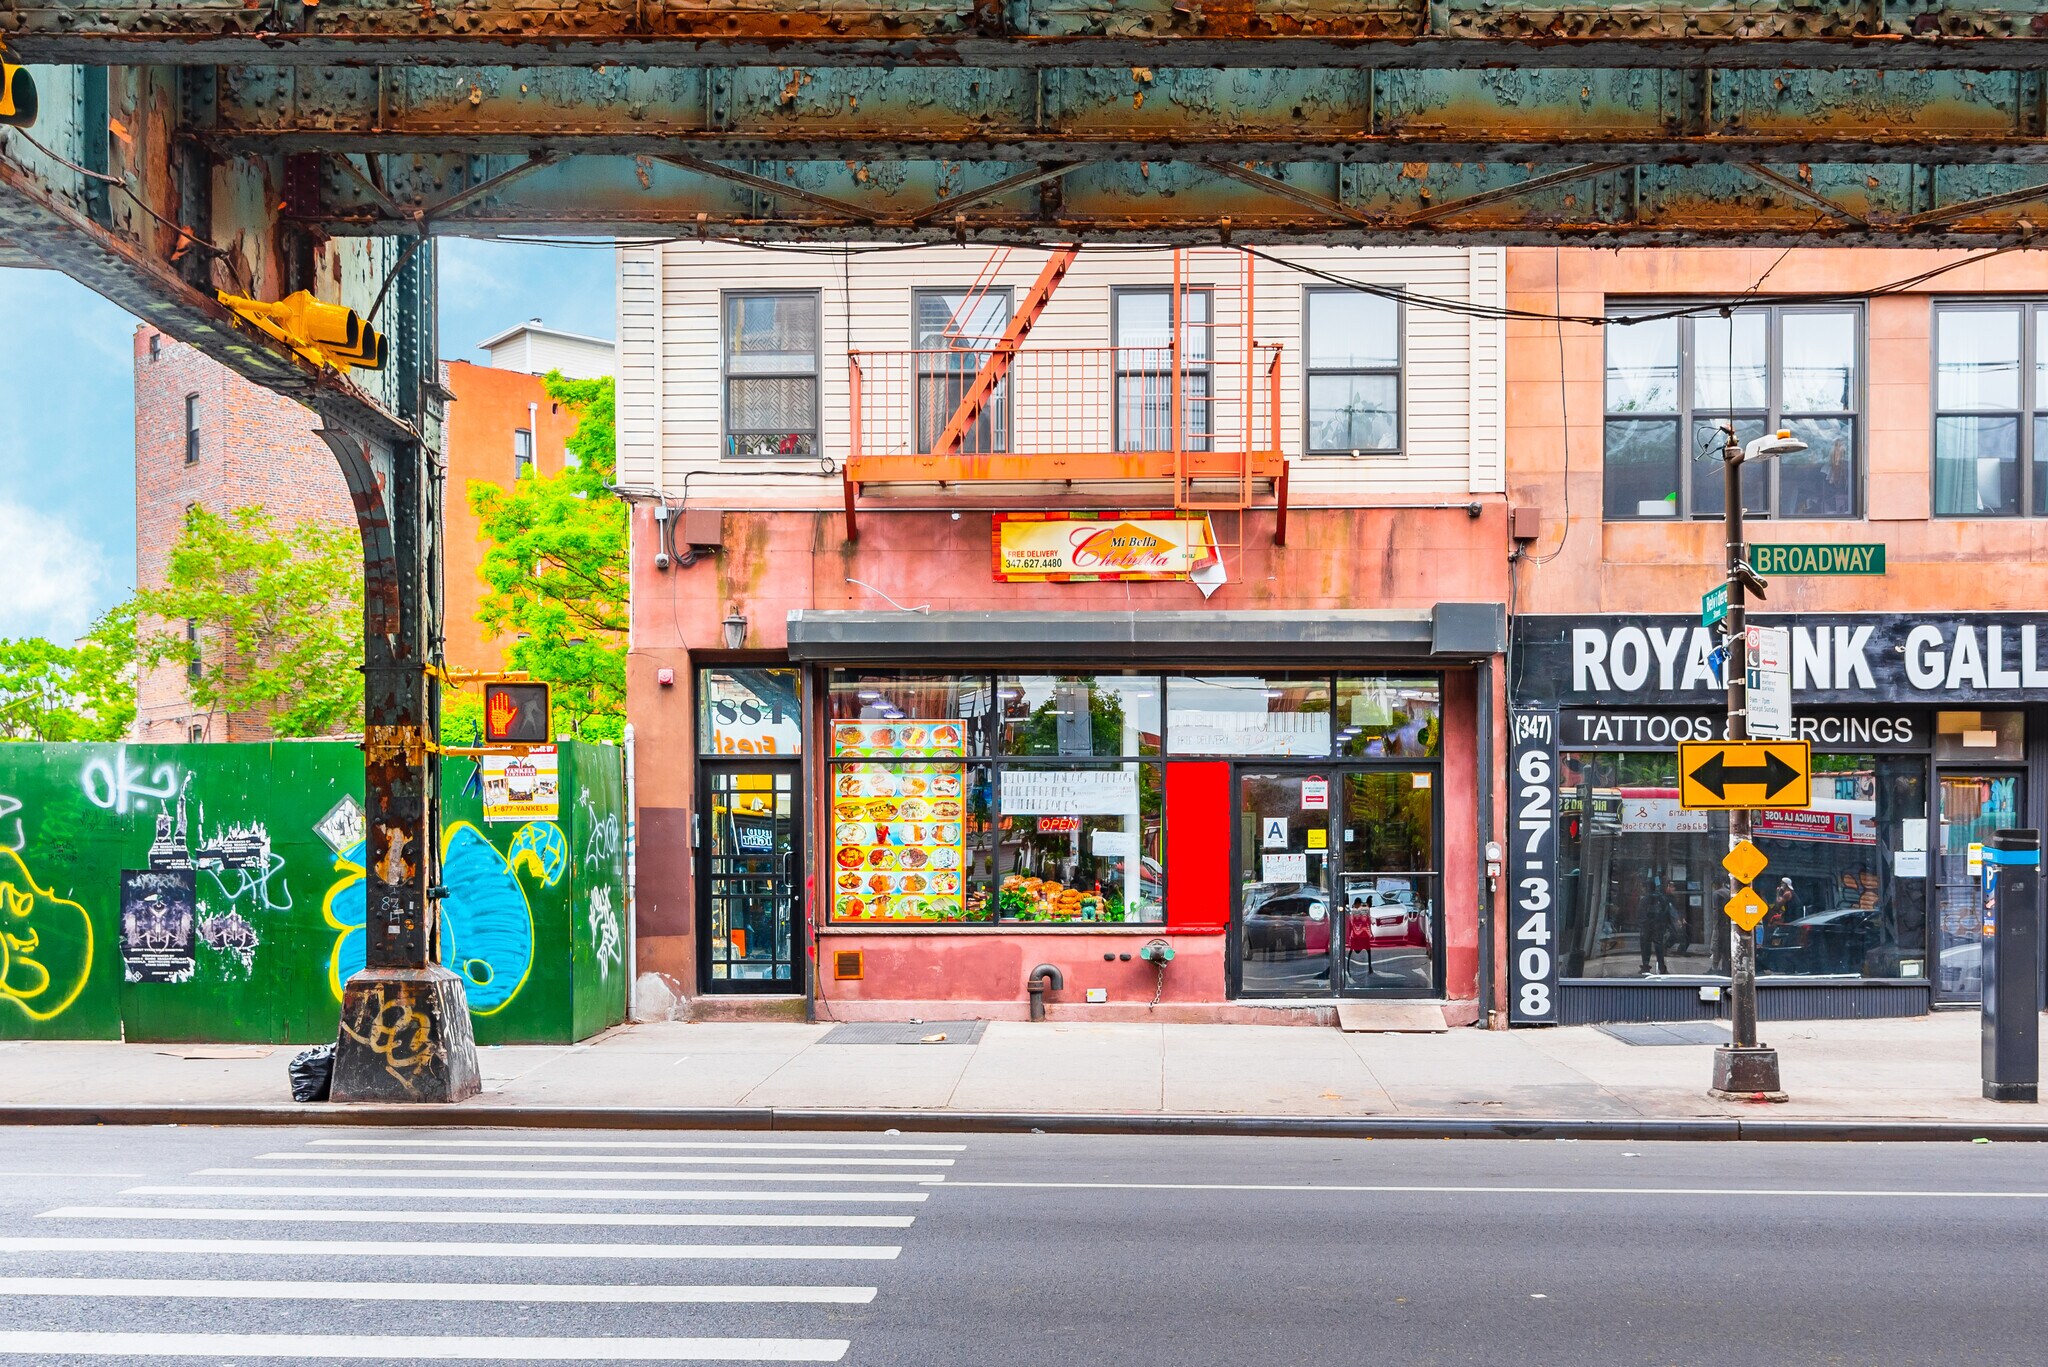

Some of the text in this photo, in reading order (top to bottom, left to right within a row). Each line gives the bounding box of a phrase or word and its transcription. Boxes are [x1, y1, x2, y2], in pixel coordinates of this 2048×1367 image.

[1110, 536, 1156, 548] Mi Bella
[1008, 550, 1058, 558] FREE DELIVERY
[1757, 546, 1875, 572] BROADWAY
[1006, 558, 1062, 569] 347.627.4480
[1774, 626, 1877, 690] NK
[1904, 624, 2048, 690] GALL
[1751, 672, 1758, 688] 1
[716, 698, 786, 726] 884
[1750, 704, 1779, 715] Except Sunday
[1515, 714, 1552, 747] (347)
[1576, 714, 1712, 742] TATTOOS
[1752, 716, 1913, 743] RCINGS
[1196, 734, 1229, 745] DELIVERY
[1041, 820, 1079, 830] OPEN
[1268, 822, 1283, 839] A
